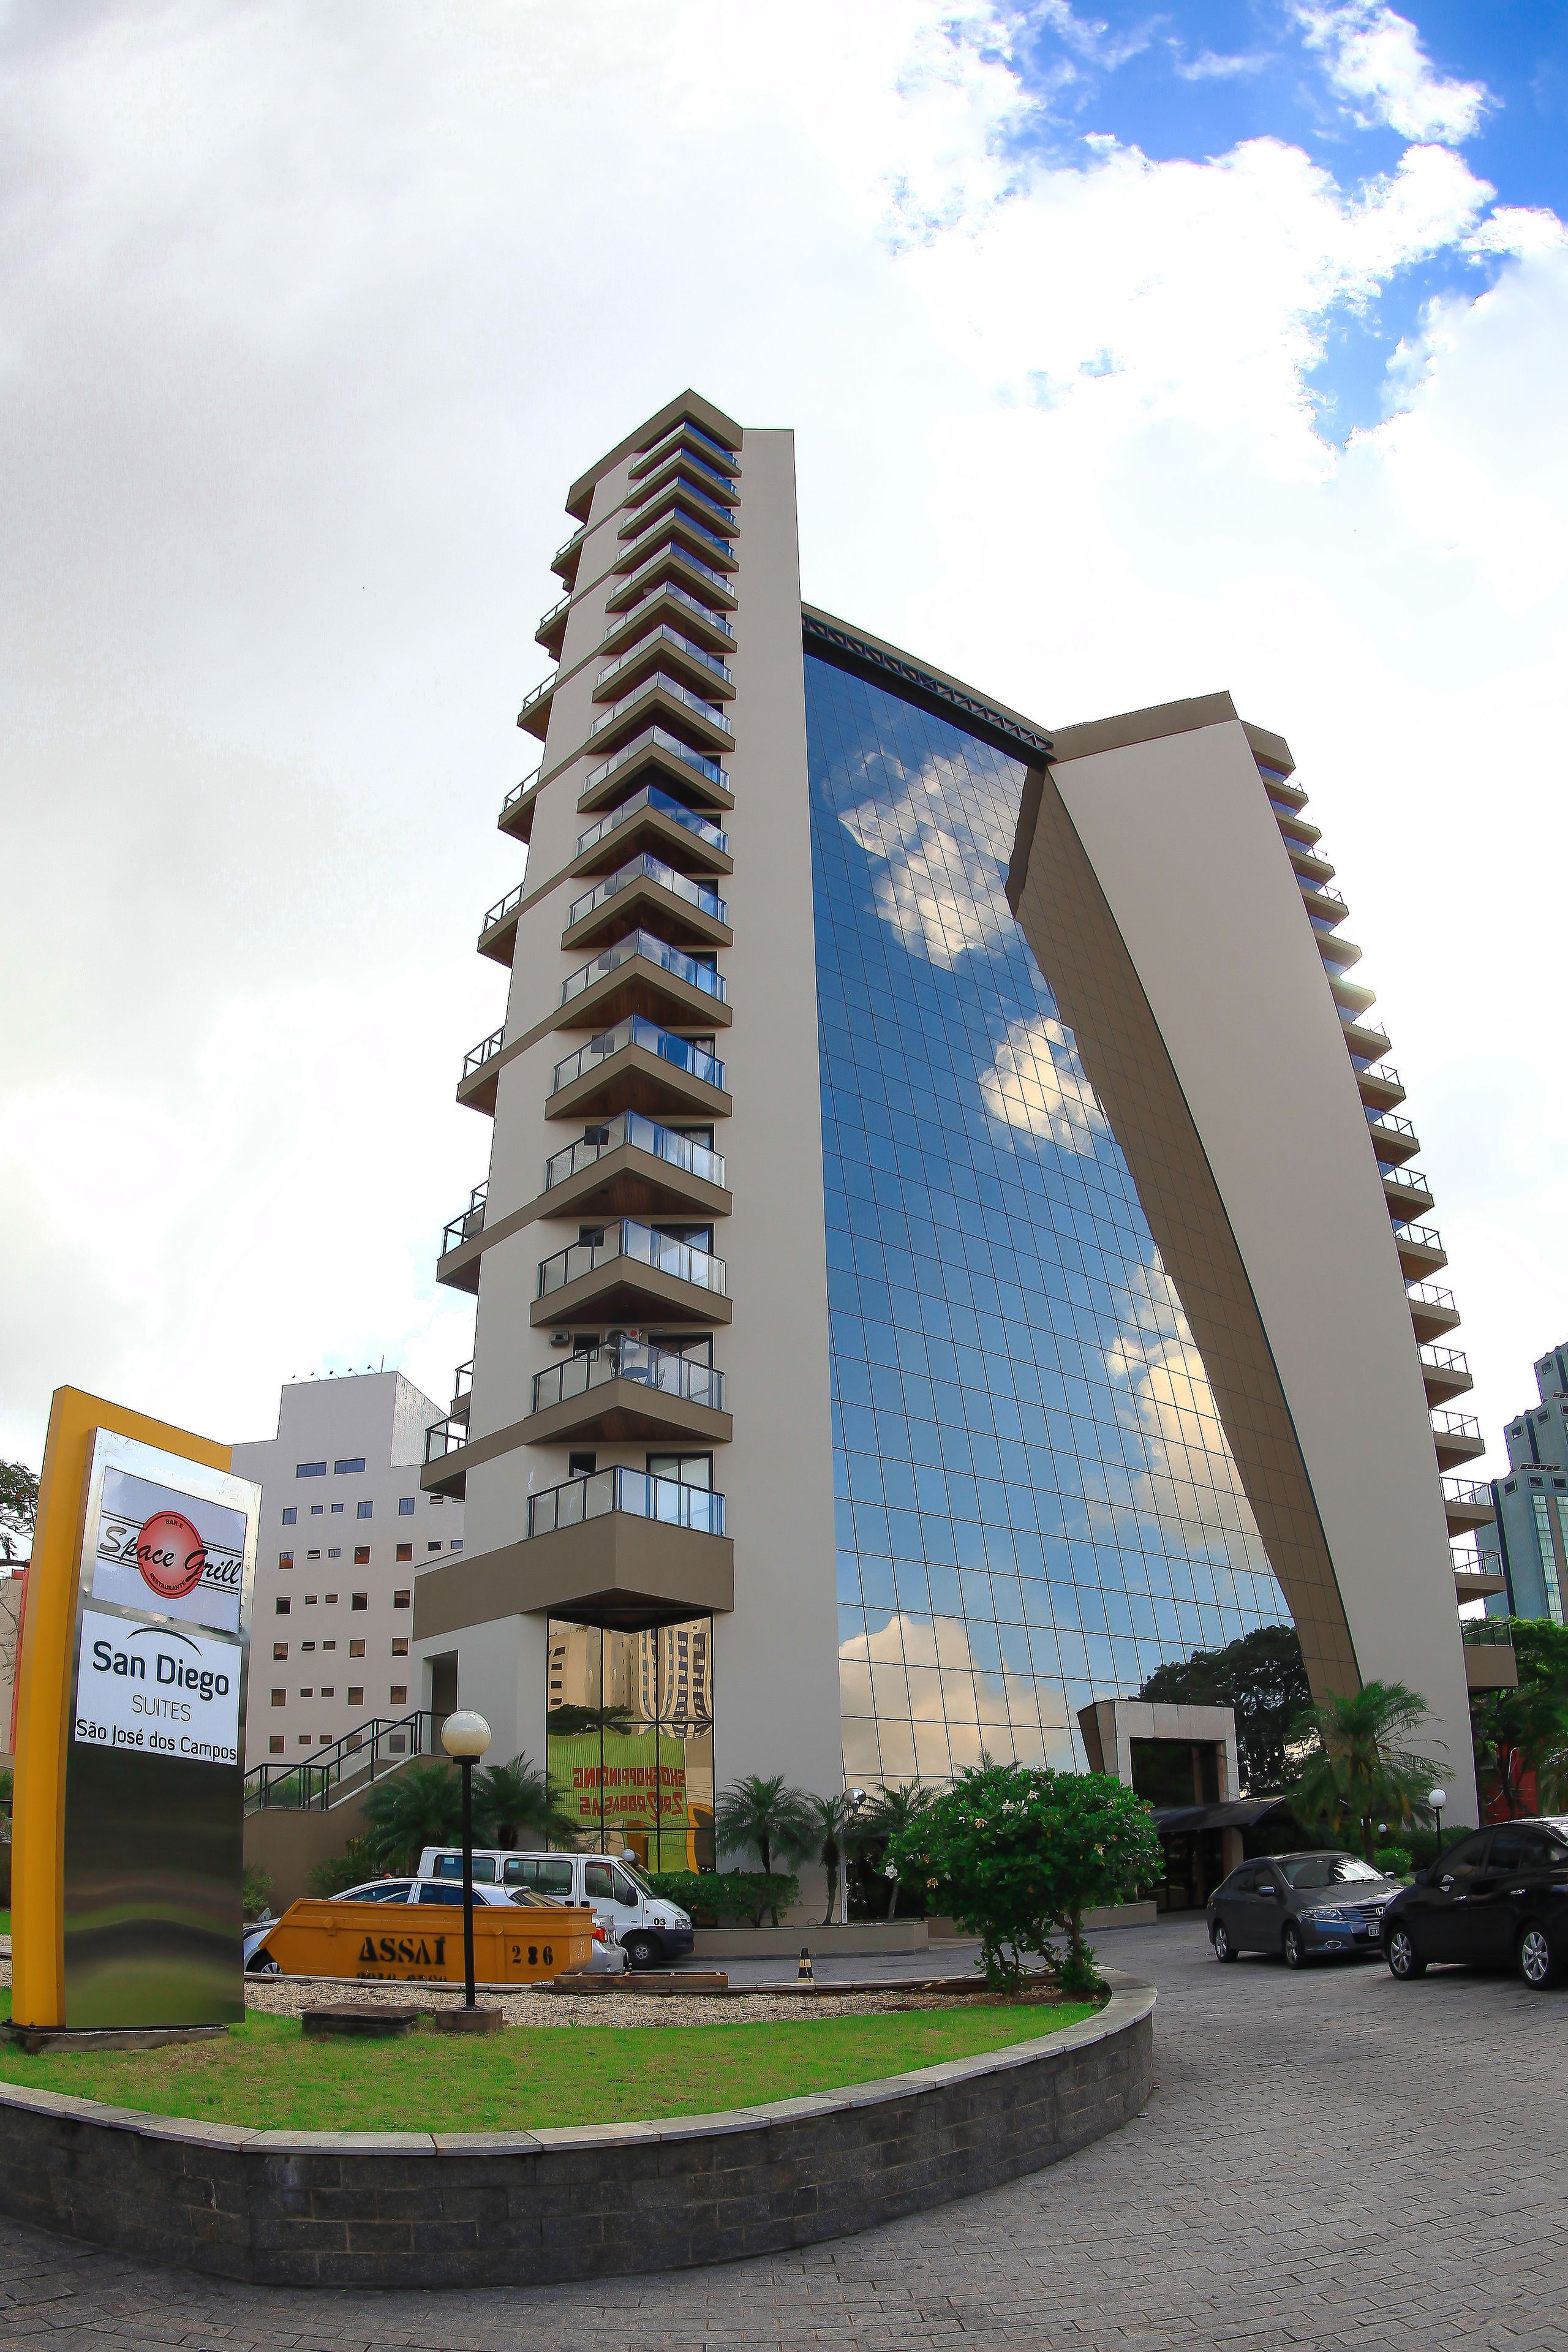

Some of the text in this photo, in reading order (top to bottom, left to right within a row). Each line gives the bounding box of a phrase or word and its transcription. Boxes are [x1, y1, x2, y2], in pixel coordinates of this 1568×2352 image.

[100, 1526, 243, 1585] Space Grill
[92, 1640, 229, 1701] San Diego
[132, 1695, 191, 1722] SUITES
[77, 1719, 236, 1761] São José dos Campos
[358, 1936, 446, 1966] ASSAÍ
[511, 1945, 554, 1966] 286
